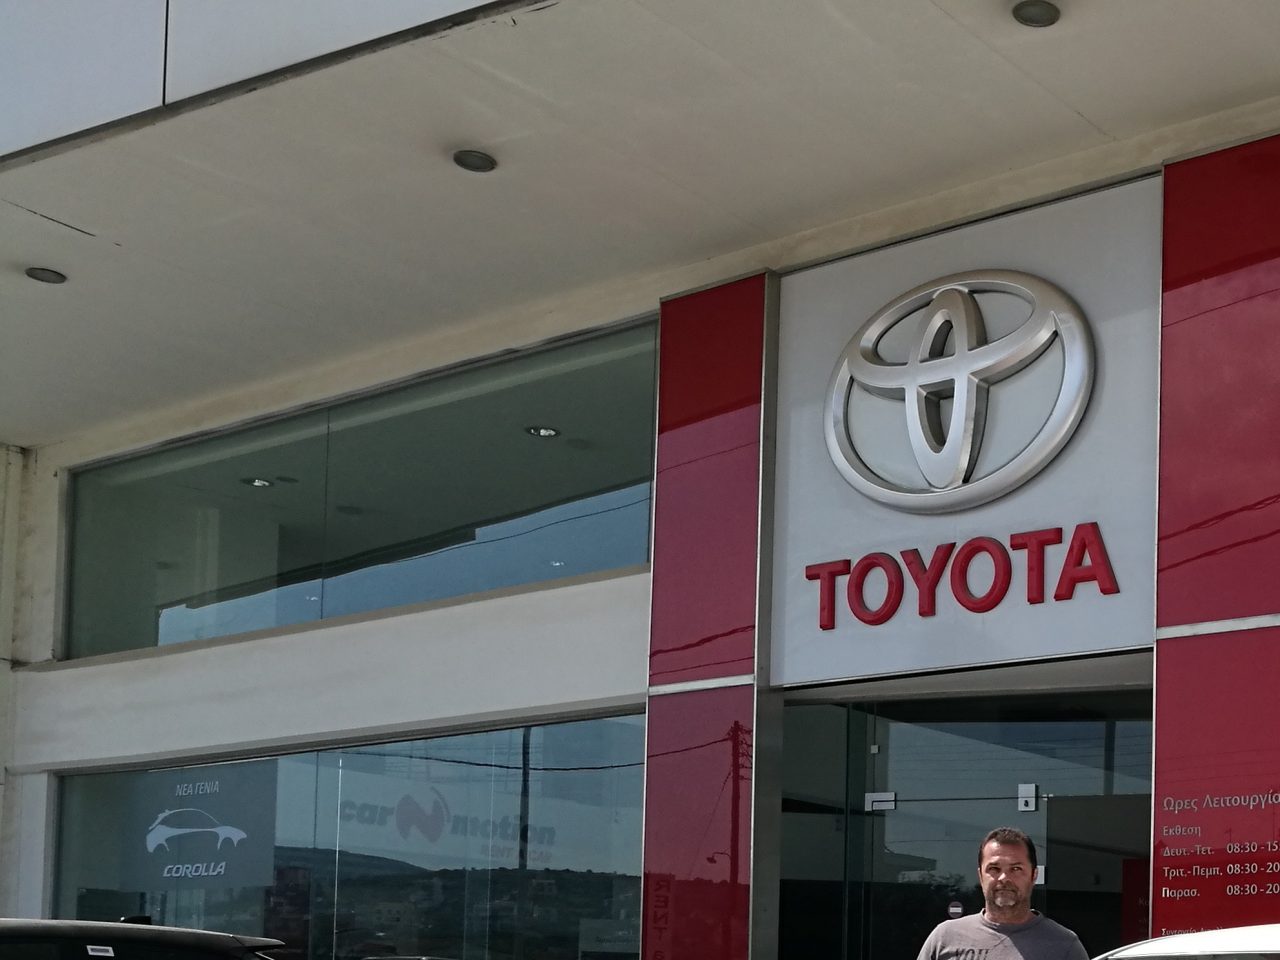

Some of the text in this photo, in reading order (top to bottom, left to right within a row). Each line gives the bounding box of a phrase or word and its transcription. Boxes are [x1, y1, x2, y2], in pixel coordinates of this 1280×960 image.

[805, 521, 1120, 631] TOYOTA
[175, 781, 220, 797] ΝΕΑ ΓΕΝΙΑ
[1163, 797, 1198, 814] Ωρες
[1163, 825, 1201, 838] Εκθεση
[1226, 841, 1258, 854] 08:30
[163, 861, 226, 879] COROLLA
[1226, 863, 1258, 876] 08:30
[1162, 887, 1200, 900] Παρασ.
[1226, 884, 1258, 896] 08:30
